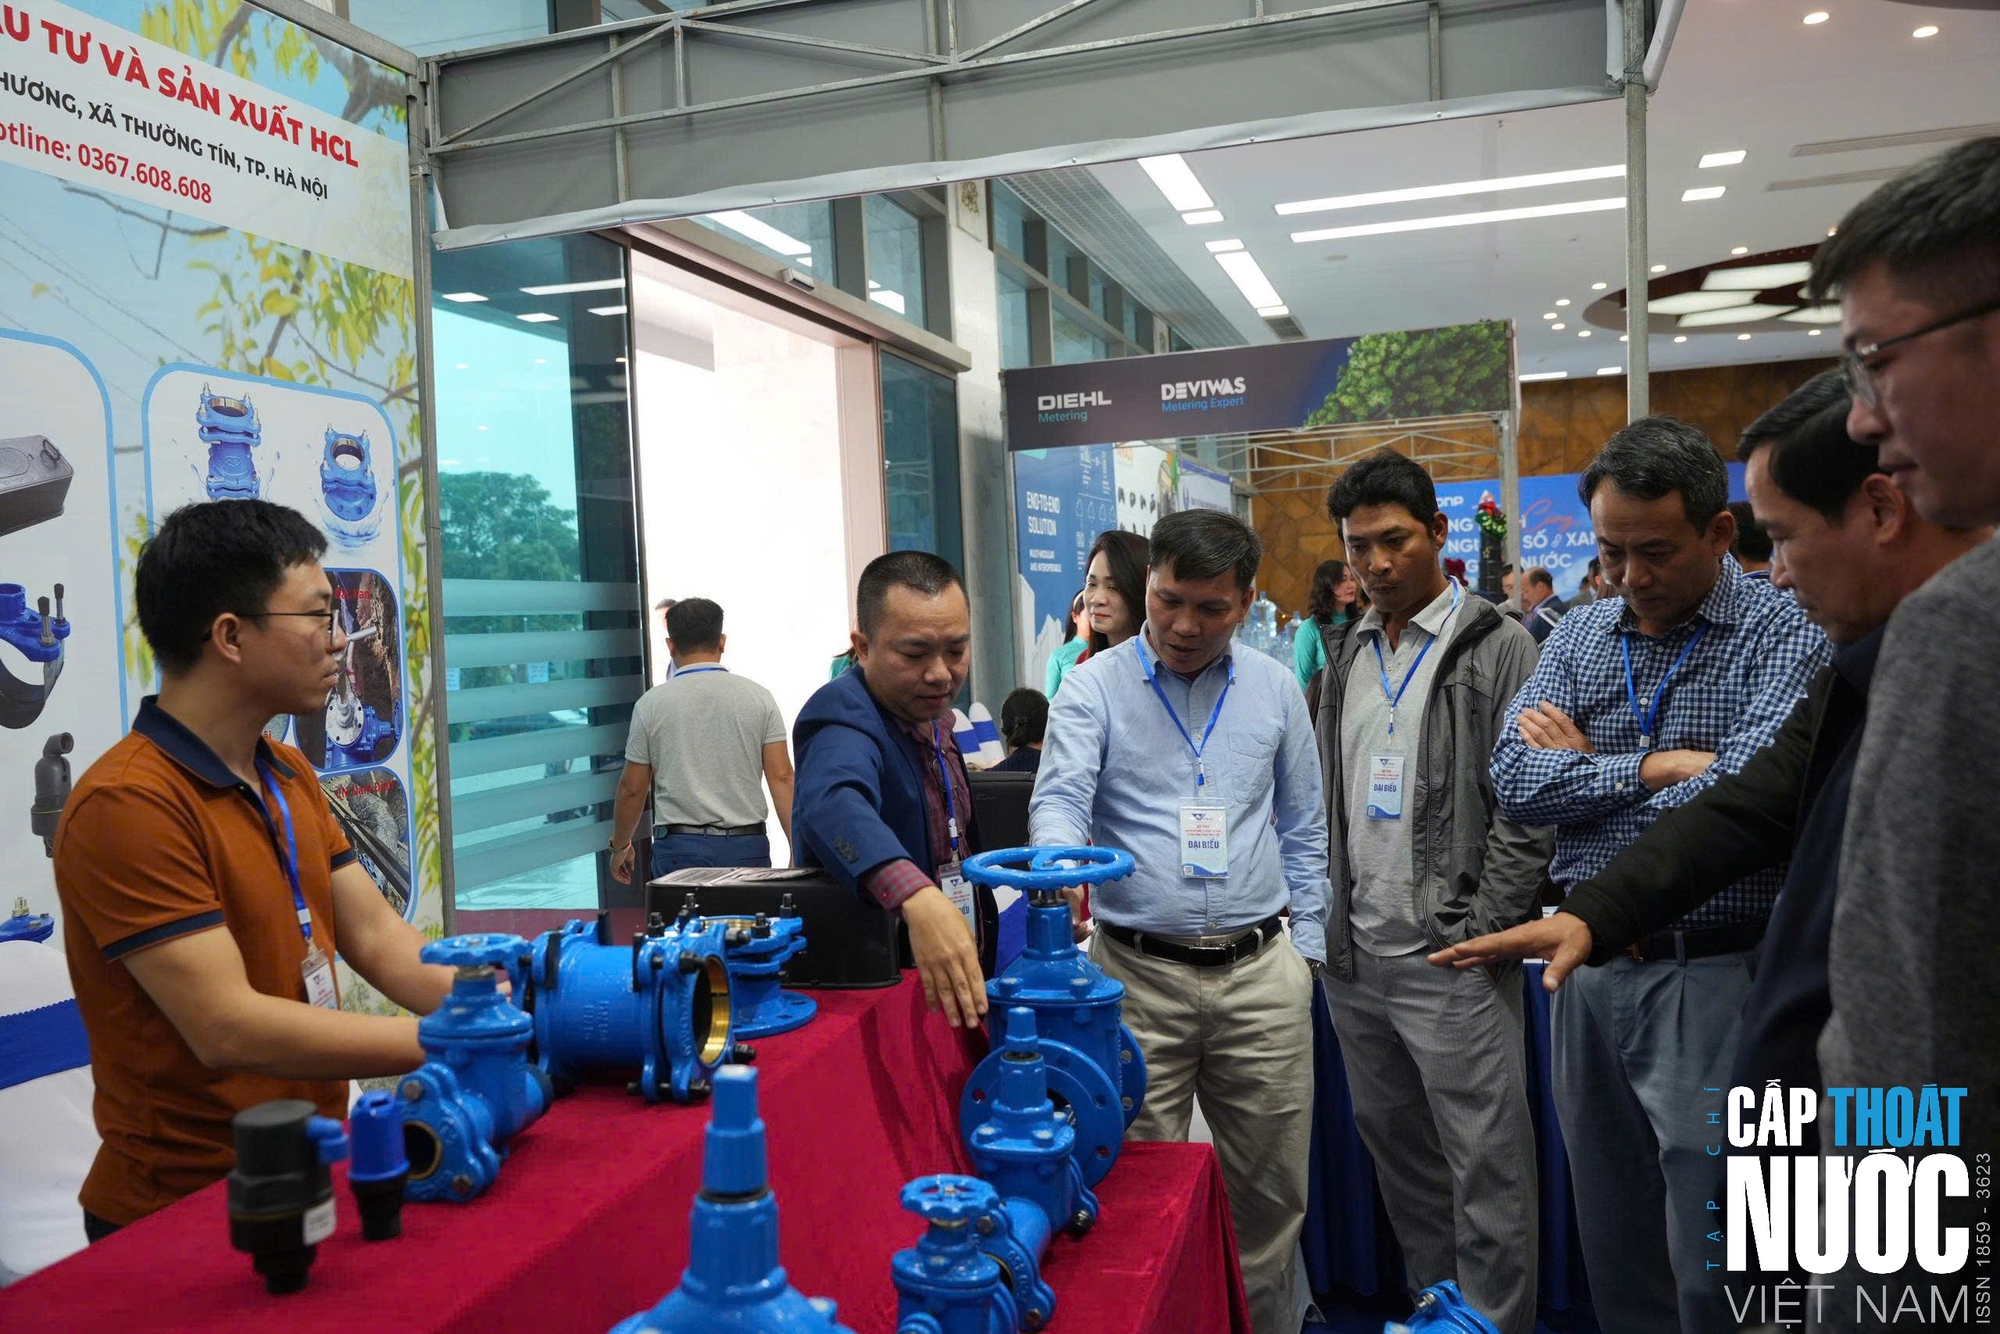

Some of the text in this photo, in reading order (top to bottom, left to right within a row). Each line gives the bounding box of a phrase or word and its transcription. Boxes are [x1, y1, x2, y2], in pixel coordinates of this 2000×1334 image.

[41, 19, 91, 65] TƯ
[99, 42, 150, 89] VÀ
[158, 65, 220, 116] SẢN
[228, 93, 303, 146] XUẤT
[311, 125, 358, 168] HCL
[88, 101, 117, 128] XÃ
[121, 113, 203, 157] THƯỜNG
[207, 143, 241, 173] TÍN,
[244, 156, 270, 180] TP.
[274, 167, 297, 190] HÀ
[301, 176, 328, 201] NỘI
[78, 143, 213, 204] 0367.608.608
[1161, 376, 1246, 401] DEVIWAS
[1038, 391, 1112, 411] DIEHL
[1161, 396, 1245, 413] Metering Expert
[1038, 410, 1088, 423] Metering
[1027, 515, 1057, 536] SOLUTION
[1522, 528, 1548, 549] SỐ
[1188, 837, 1220, 851] ĐẠI BIỂU
